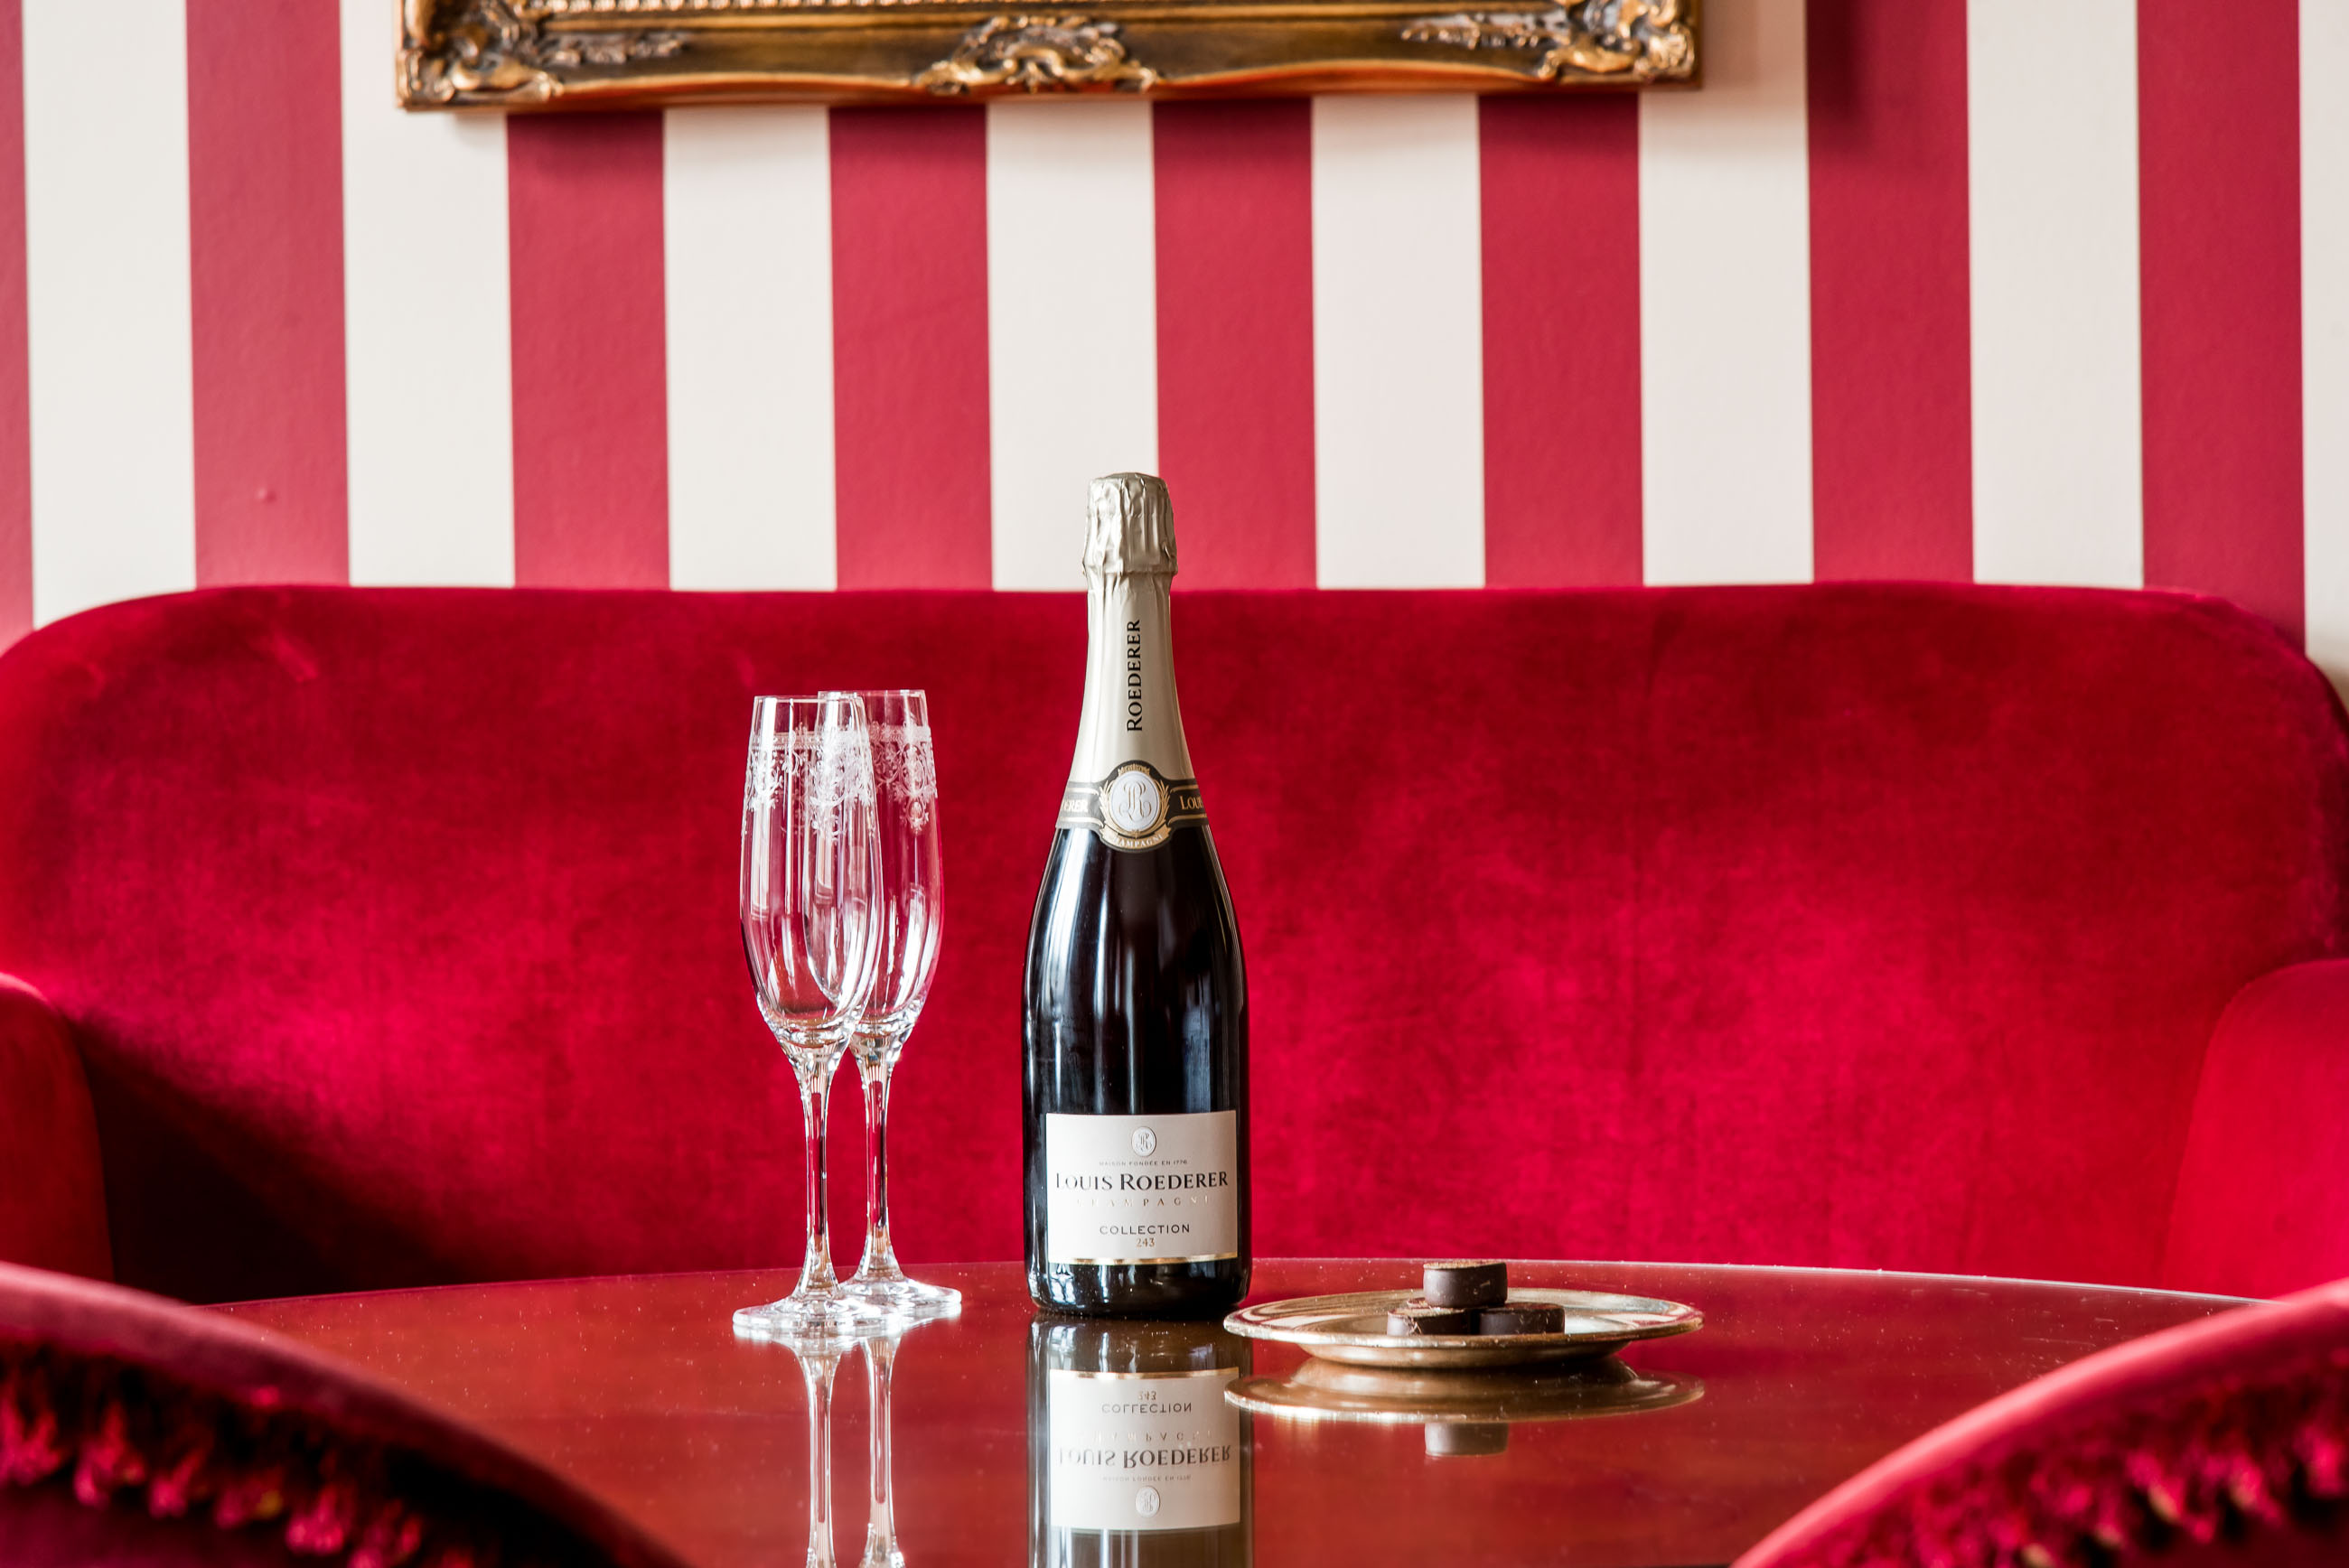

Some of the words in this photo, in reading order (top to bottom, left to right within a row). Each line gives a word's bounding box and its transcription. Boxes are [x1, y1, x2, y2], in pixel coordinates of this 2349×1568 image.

[1127, 619, 1143, 732] ROEDERER
[1056, 1172, 1113, 1190] LOUIS
[1120, 1171, 1229, 1190] ROEDERER
[1100, 1224, 1190, 1235] COLLECTION
[1136, 1237, 1156, 1247] 243
